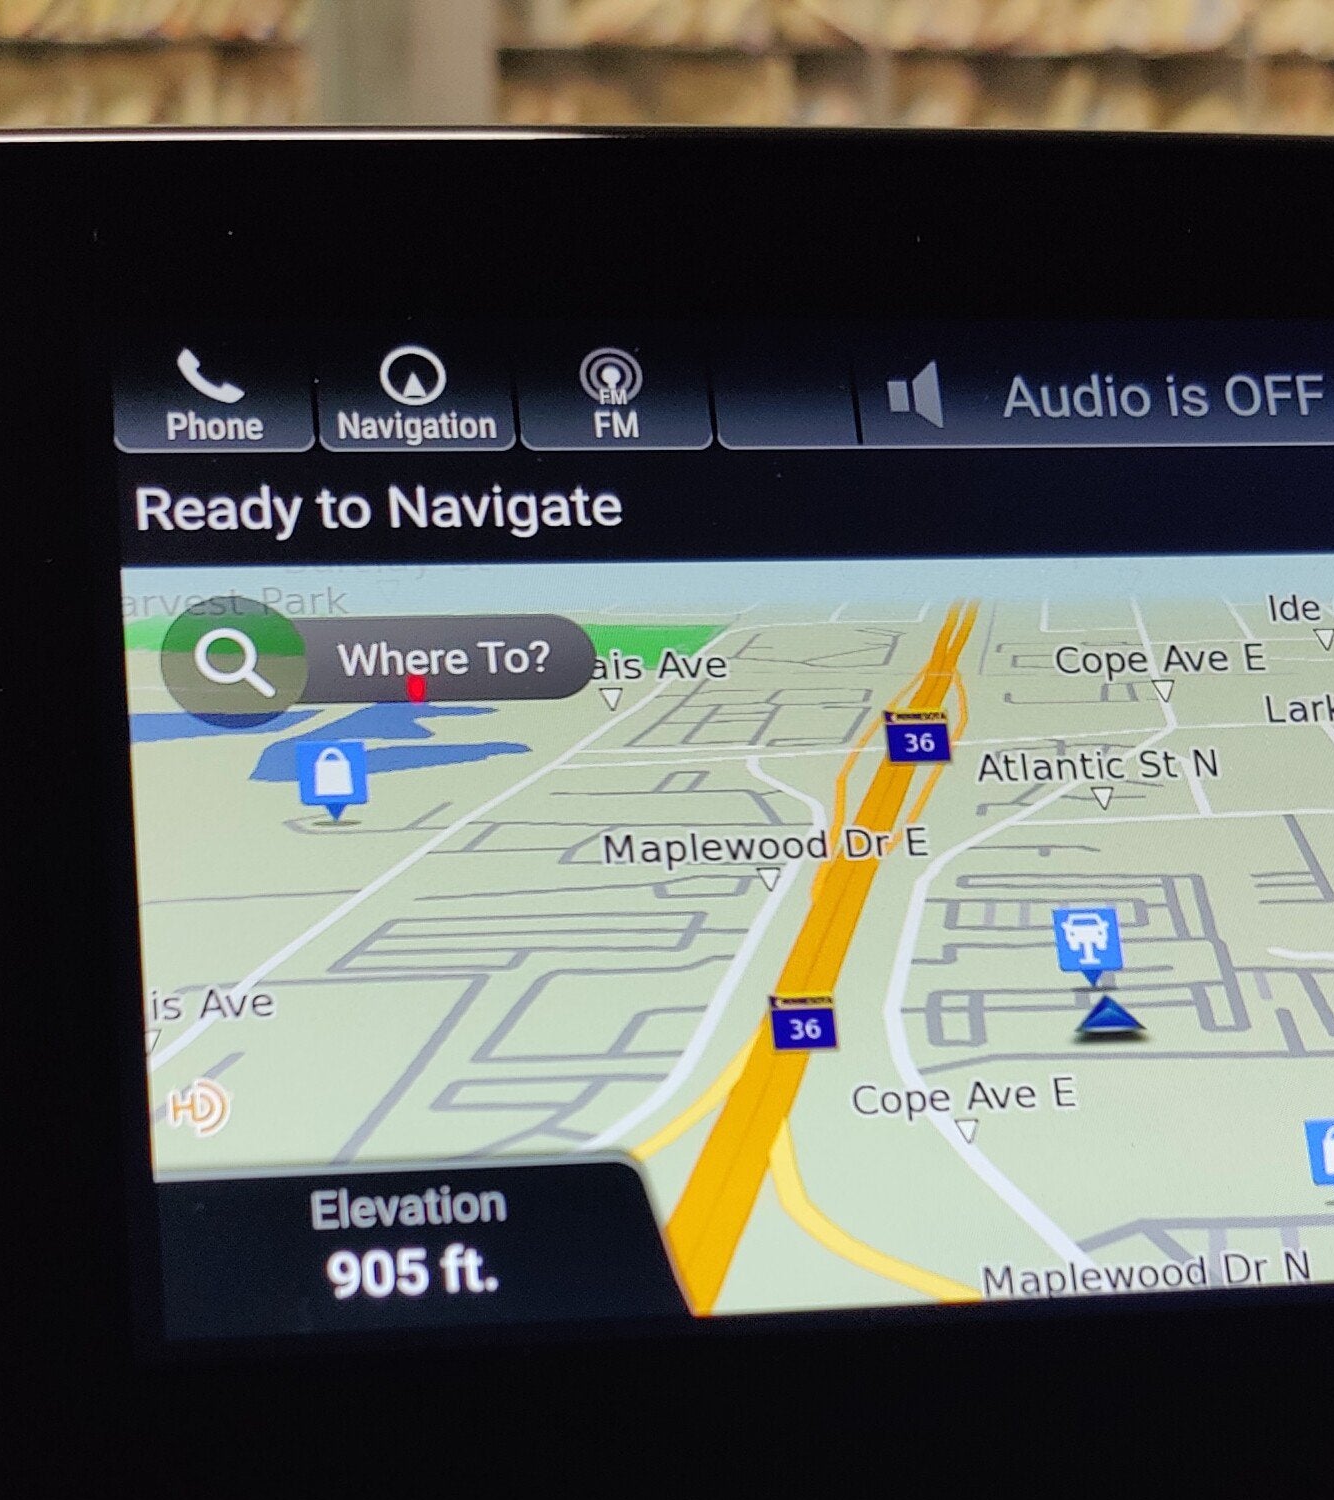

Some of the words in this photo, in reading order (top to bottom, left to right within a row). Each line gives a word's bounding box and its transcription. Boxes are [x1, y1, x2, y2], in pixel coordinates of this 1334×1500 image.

[1003, 373, 1151, 419] Audio
[1167, 375, 1209, 416] is
[1224, 373, 1325, 417] OFF
[166, 409, 265, 441] Phone
[337, 410, 498, 445] Navigation
[593, 409, 640, 439] FM
[134, 483, 303, 542] Ready
[315, 487, 371, 529] to
[389, 483, 623, 538] Navigate
[261, 585, 349, 617] Park
[1269, 593, 1321, 622] Ide
[336, 640, 470, 678] Where
[476, 640, 551, 674] To?
[657, 650, 728, 680] Ave
[1055, 645, 1149, 681] Cope
[1163, 644, 1229, 672] Ave
[1243, 642, 1267, 672] E
[903, 731, 937, 754] 36
[977, 749, 1126, 783] Atlantic
[1140, 748, 1180, 780] St
[1193, 747, 1220, 777] N
[602, 827, 829, 870] Maplewood
[843, 828, 892, 860] Dr
[905, 827, 929, 858] E
[200, 988, 275, 1019] Ave
[788, 1017, 823, 1041] 36
[851, 1083, 951, 1122] Cope
[966, 1079, 1037, 1111] Ave
[1052, 1076, 1077, 1108] E
[310, 1185, 507, 1230] Elevation
[326, 1248, 430, 1300] 905
[440, 1242, 500, 1293] ft.
[981, 1254, 1207, 1297] Maplewood
[1223, 1252, 1267, 1285] Dr
[1283, 1249, 1311, 1282] N
